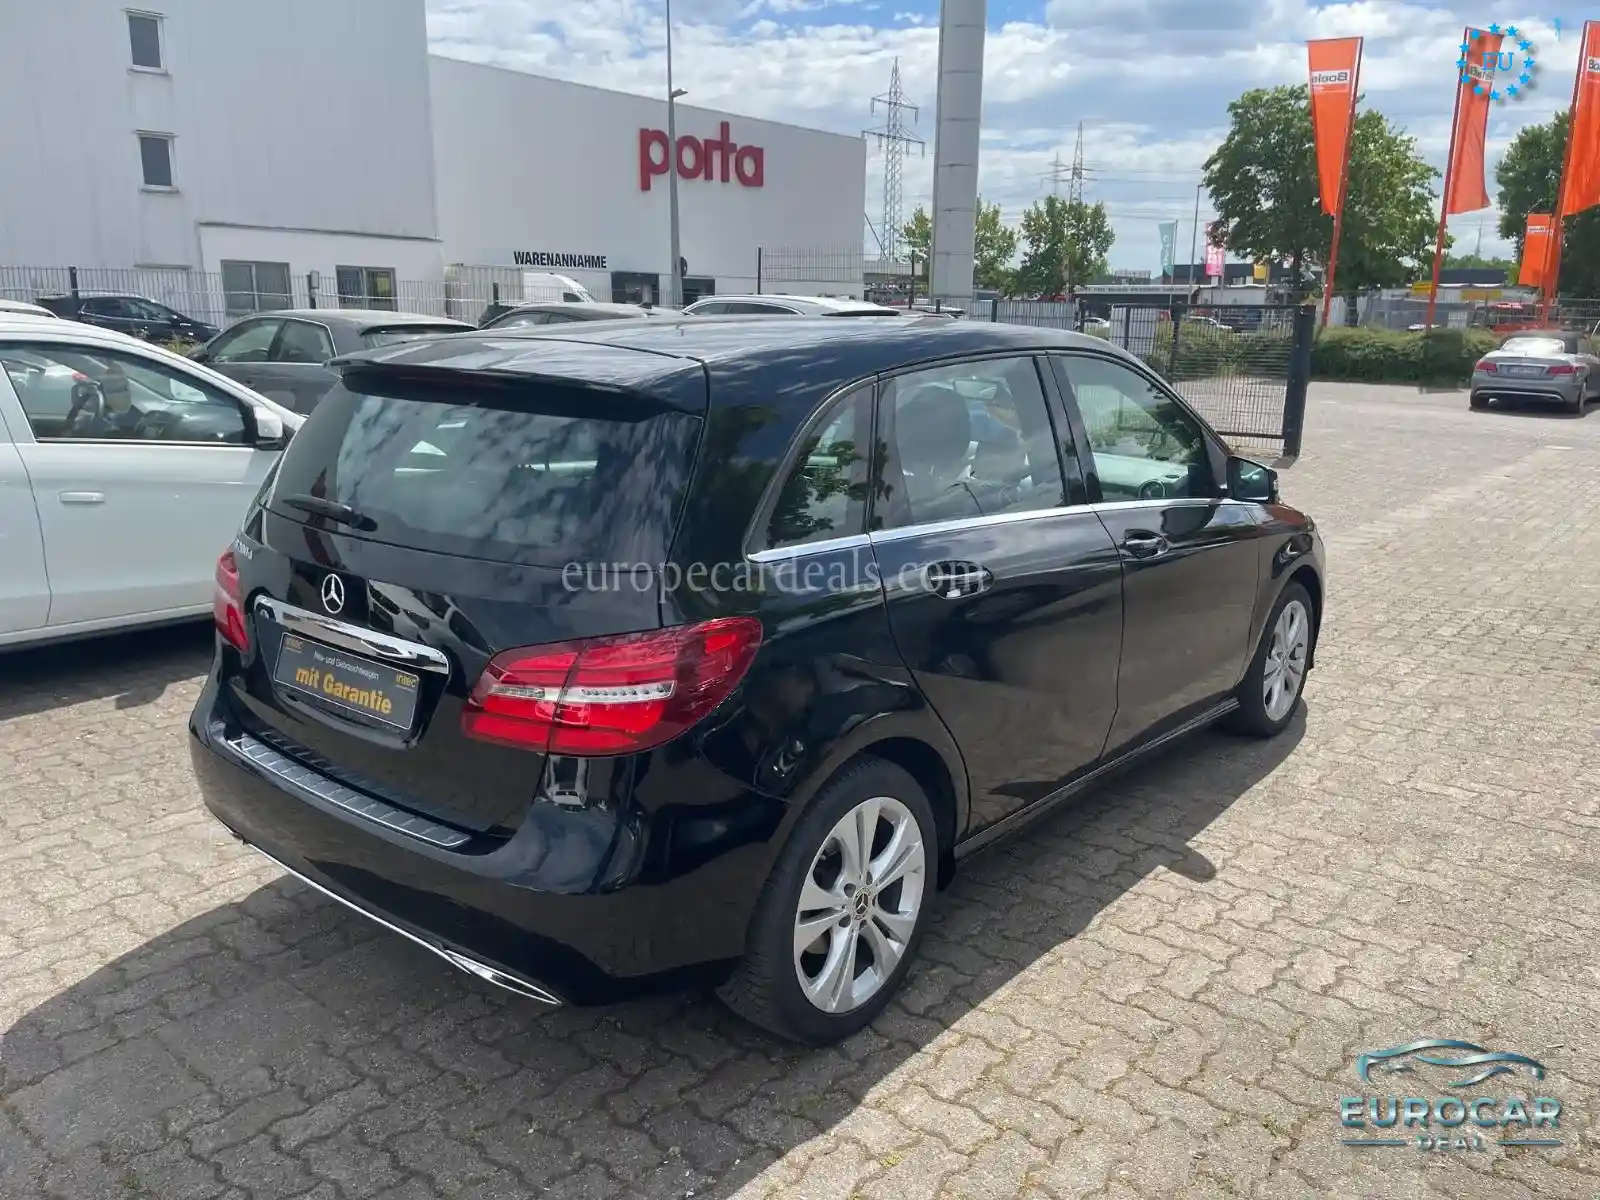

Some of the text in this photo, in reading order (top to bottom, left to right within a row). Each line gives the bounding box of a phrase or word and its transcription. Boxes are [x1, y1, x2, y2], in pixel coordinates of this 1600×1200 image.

[640, 121, 764, 191] porta
[513, 250, 607, 269] WARENANNAHME
[295, 667, 392, 714] mit Garantie
